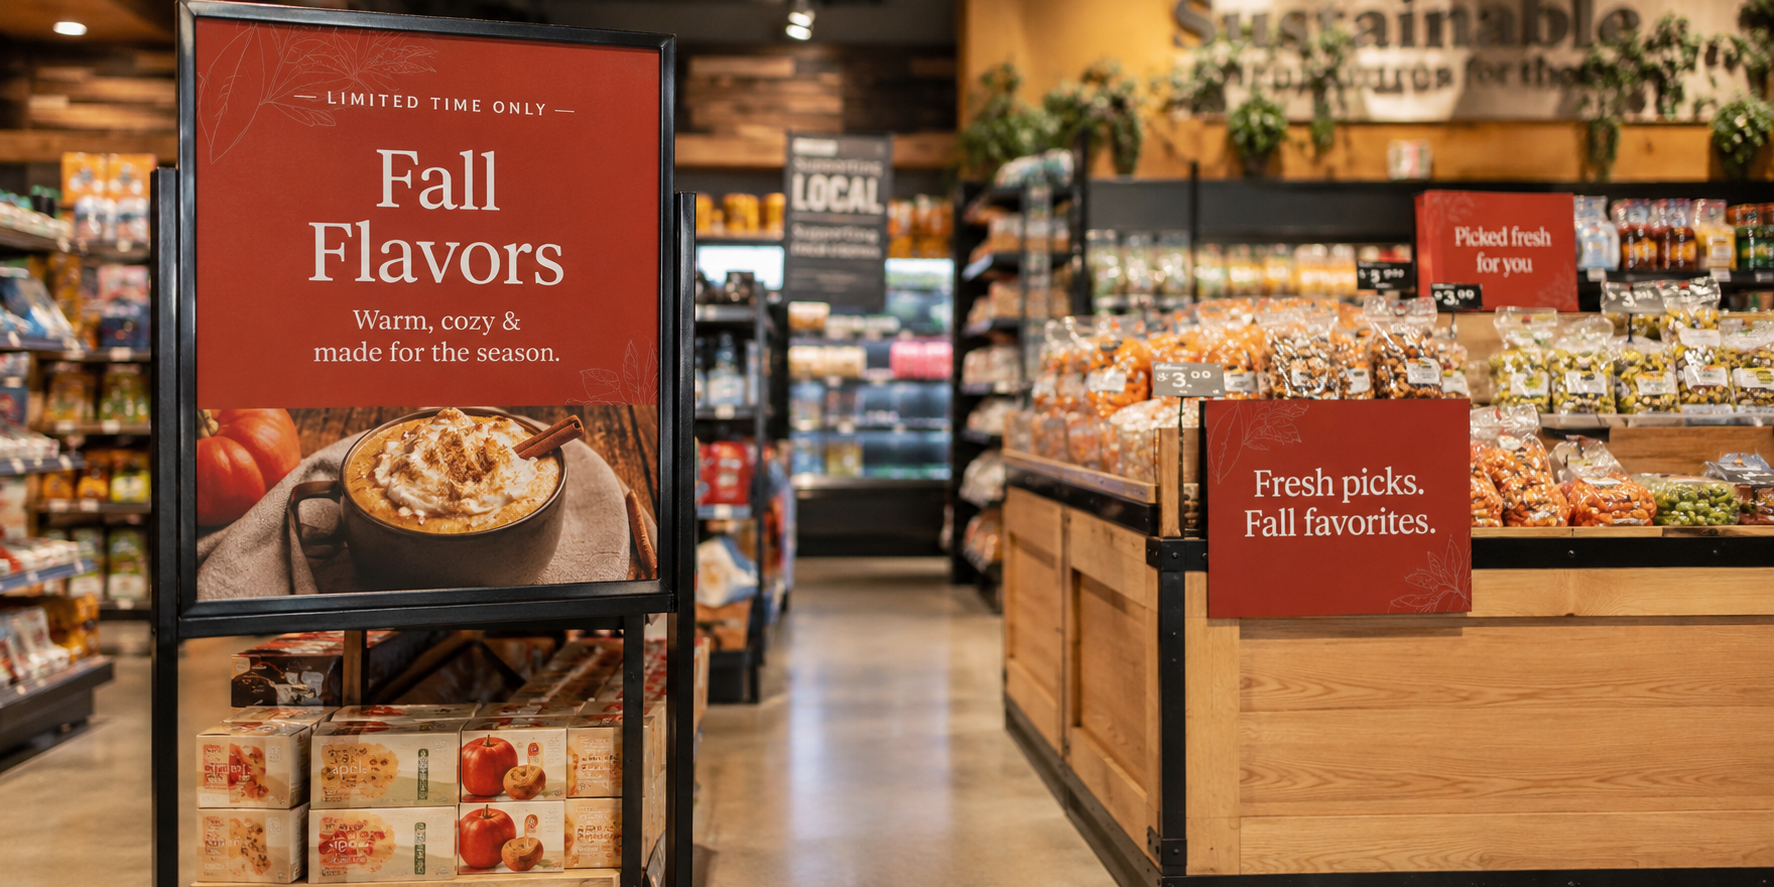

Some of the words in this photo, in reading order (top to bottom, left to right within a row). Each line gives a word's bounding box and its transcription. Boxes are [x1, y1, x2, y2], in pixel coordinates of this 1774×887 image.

[327, 90, 419, 109] LIMITED
[430, 96, 481, 113] TIME
[492, 100, 546, 116] ONLY
[376, 148, 501, 211] Fall
[791, 172, 885, 215] LOCAL
[1454, 226, 1508, 247] Picked
[1511, 225, 1552, 247] fresh
[308, 219, 564, 286] Flavors
[1476, 251, 1500, 273] for
[1502, 256, 1533, 278] you
[353, 309, 434, 334] Warm,
[441, 315, 496, 336] cozy
[502, 310, 521, 331] &
[313, 341, 383, 363] made
[389, 341, 425, 363] for
[431, 341, 470, 363] the
[476, 347, 560, 363] season.
[1253, 467, 1335, 498] Fresh
[1341, 466, 1425, 504] picks.
[1244, 507, 1297, 538] Fall
[1303, 506, 1436, 537] favorites.
